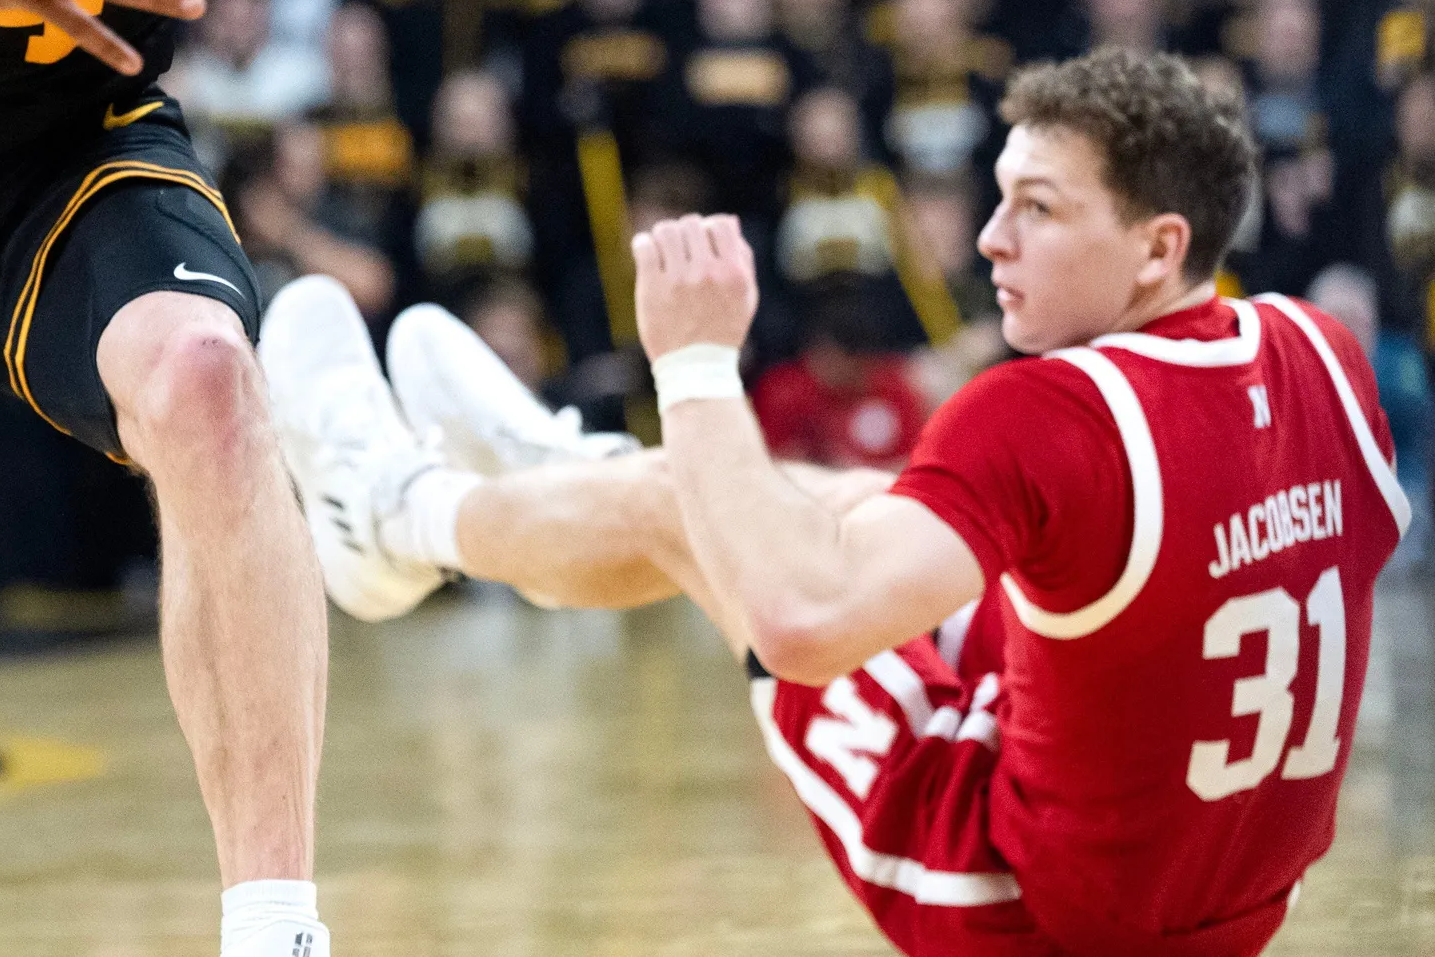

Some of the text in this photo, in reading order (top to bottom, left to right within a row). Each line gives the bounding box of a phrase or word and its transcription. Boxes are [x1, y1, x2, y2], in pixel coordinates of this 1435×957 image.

[1208, 479, 1343, 579] JACOBSEN
[804, 676, 899, 802] N
[1186, 565, 1346, 801] 31
